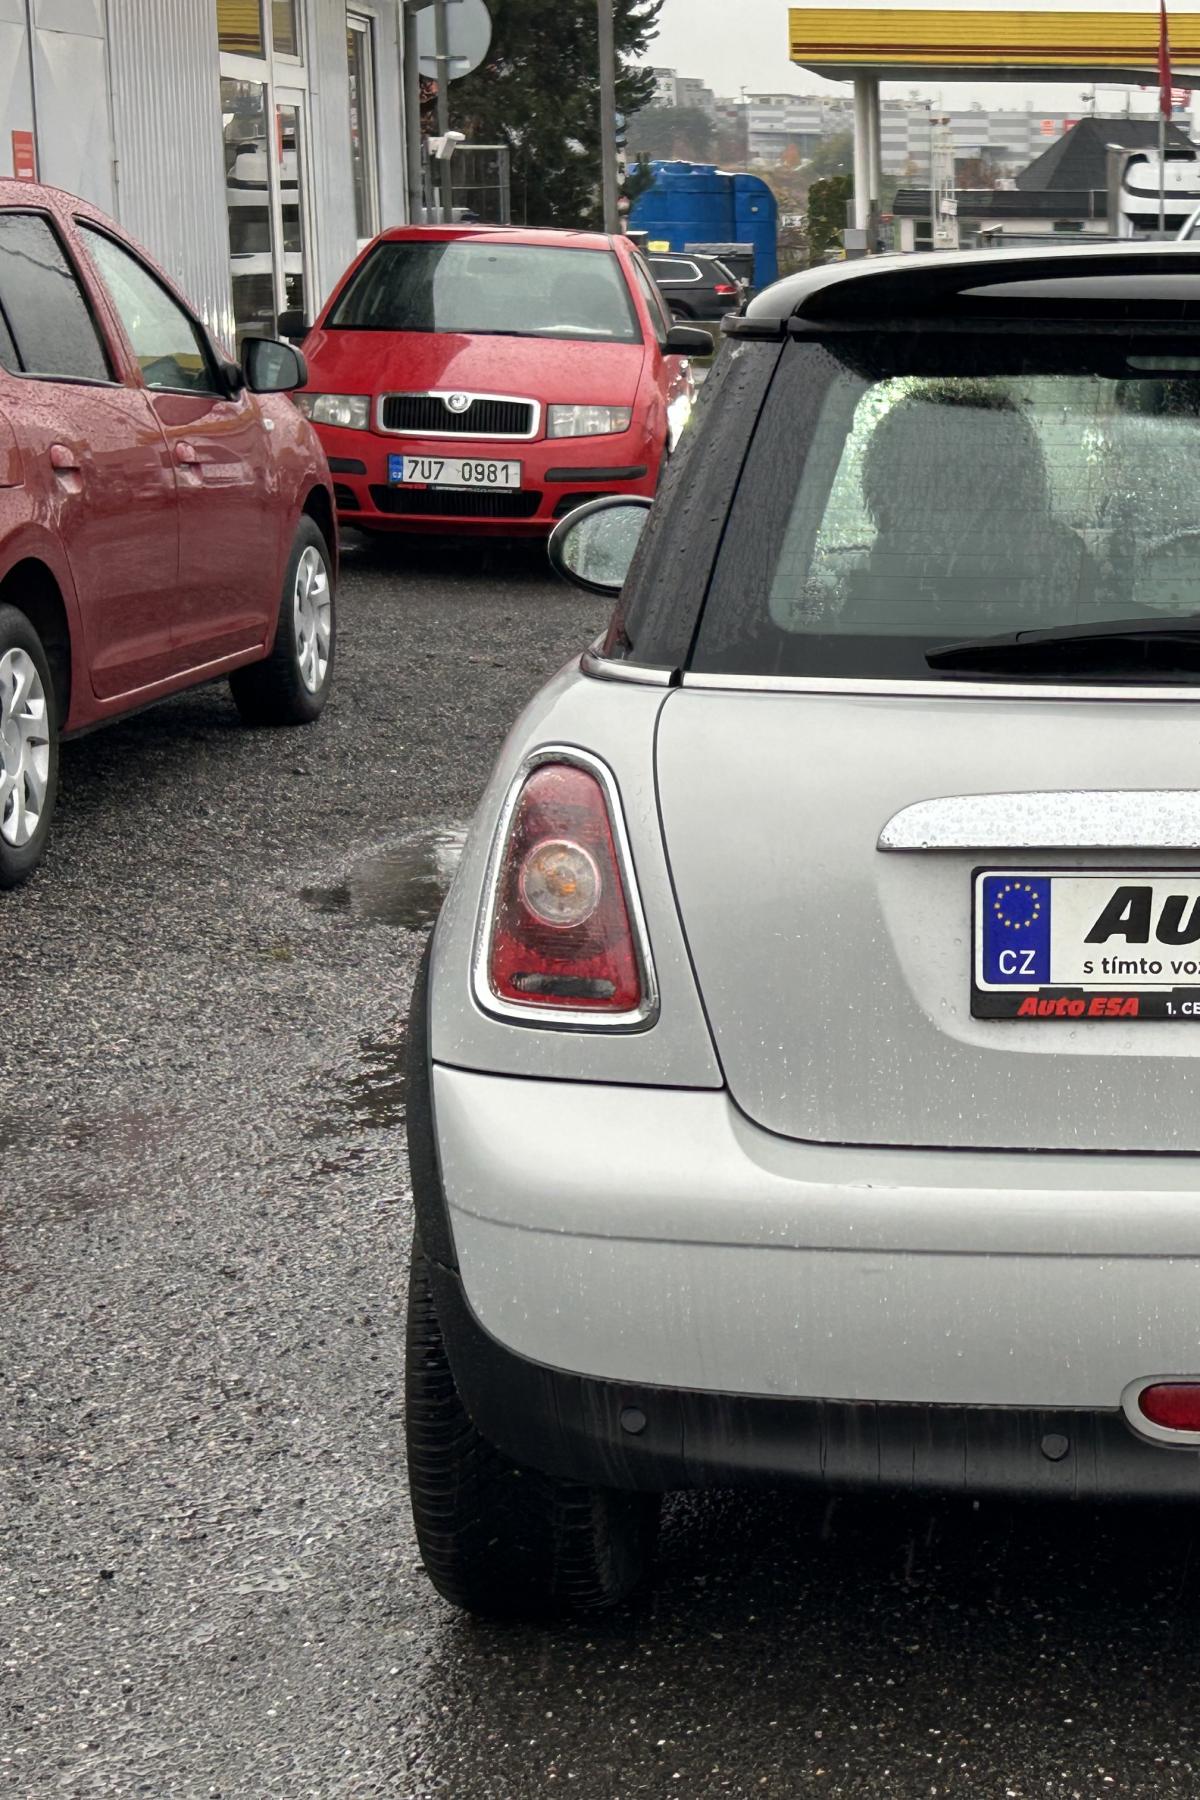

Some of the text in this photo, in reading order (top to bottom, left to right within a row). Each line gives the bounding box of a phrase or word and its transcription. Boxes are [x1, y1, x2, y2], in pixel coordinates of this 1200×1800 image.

[408, 460, 510, 484] 7U7 0981
[999, 949, 1036, 975] CZ
[1083, 960, 1094, 974] s
[1101, 956, 1163, 975] tímto
[1017, 996, 1140, 1017] Auto ESA
[1166, 1002, 1177, 1016] 1.
